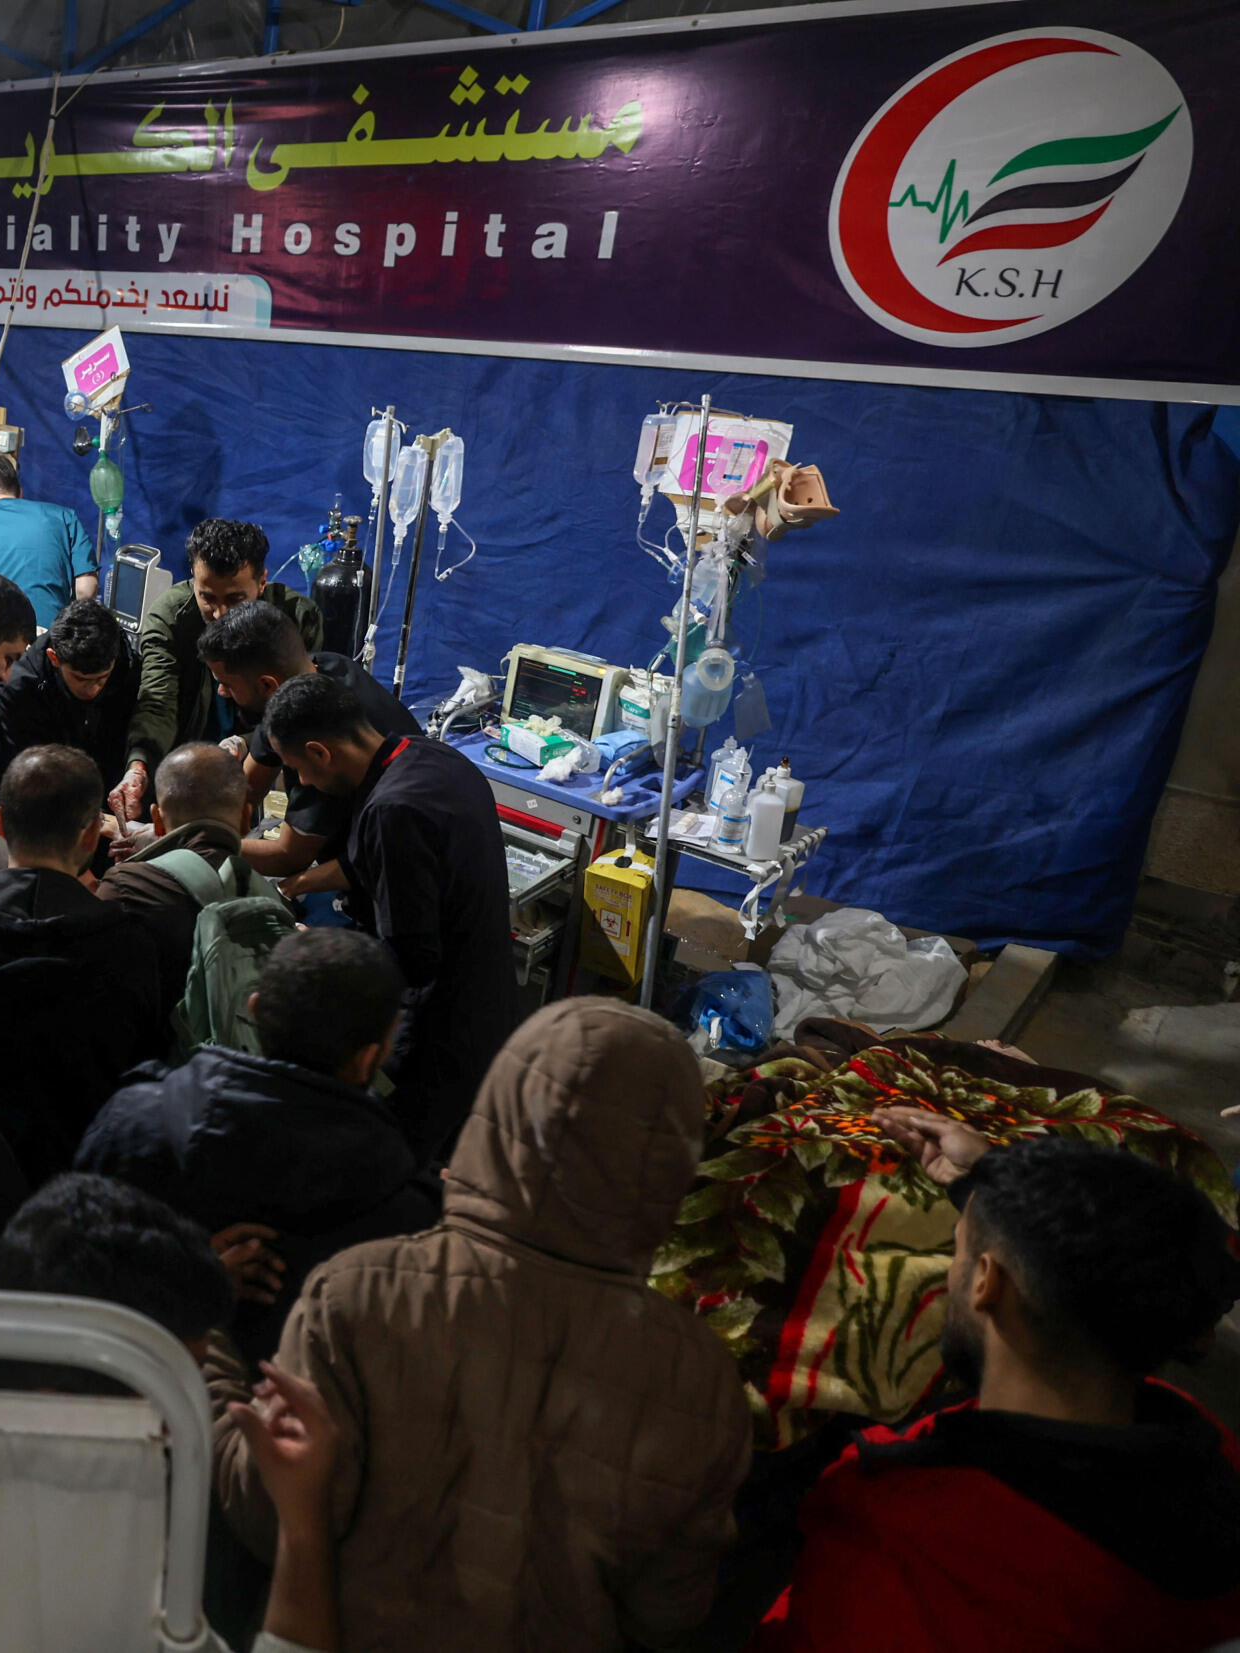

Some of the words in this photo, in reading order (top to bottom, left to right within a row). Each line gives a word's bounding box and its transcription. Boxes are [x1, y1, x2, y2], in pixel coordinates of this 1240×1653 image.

[246, 65, 643, 191] مستشفى
[231, 210, 619, 268] Hospital
[43, 278, 149, 315] بخدمتكم
[155, 284, 230, 313] نسعد
[954, 267, 1064, 299] K.S.H
[80, 352, 111, 381] سرير
